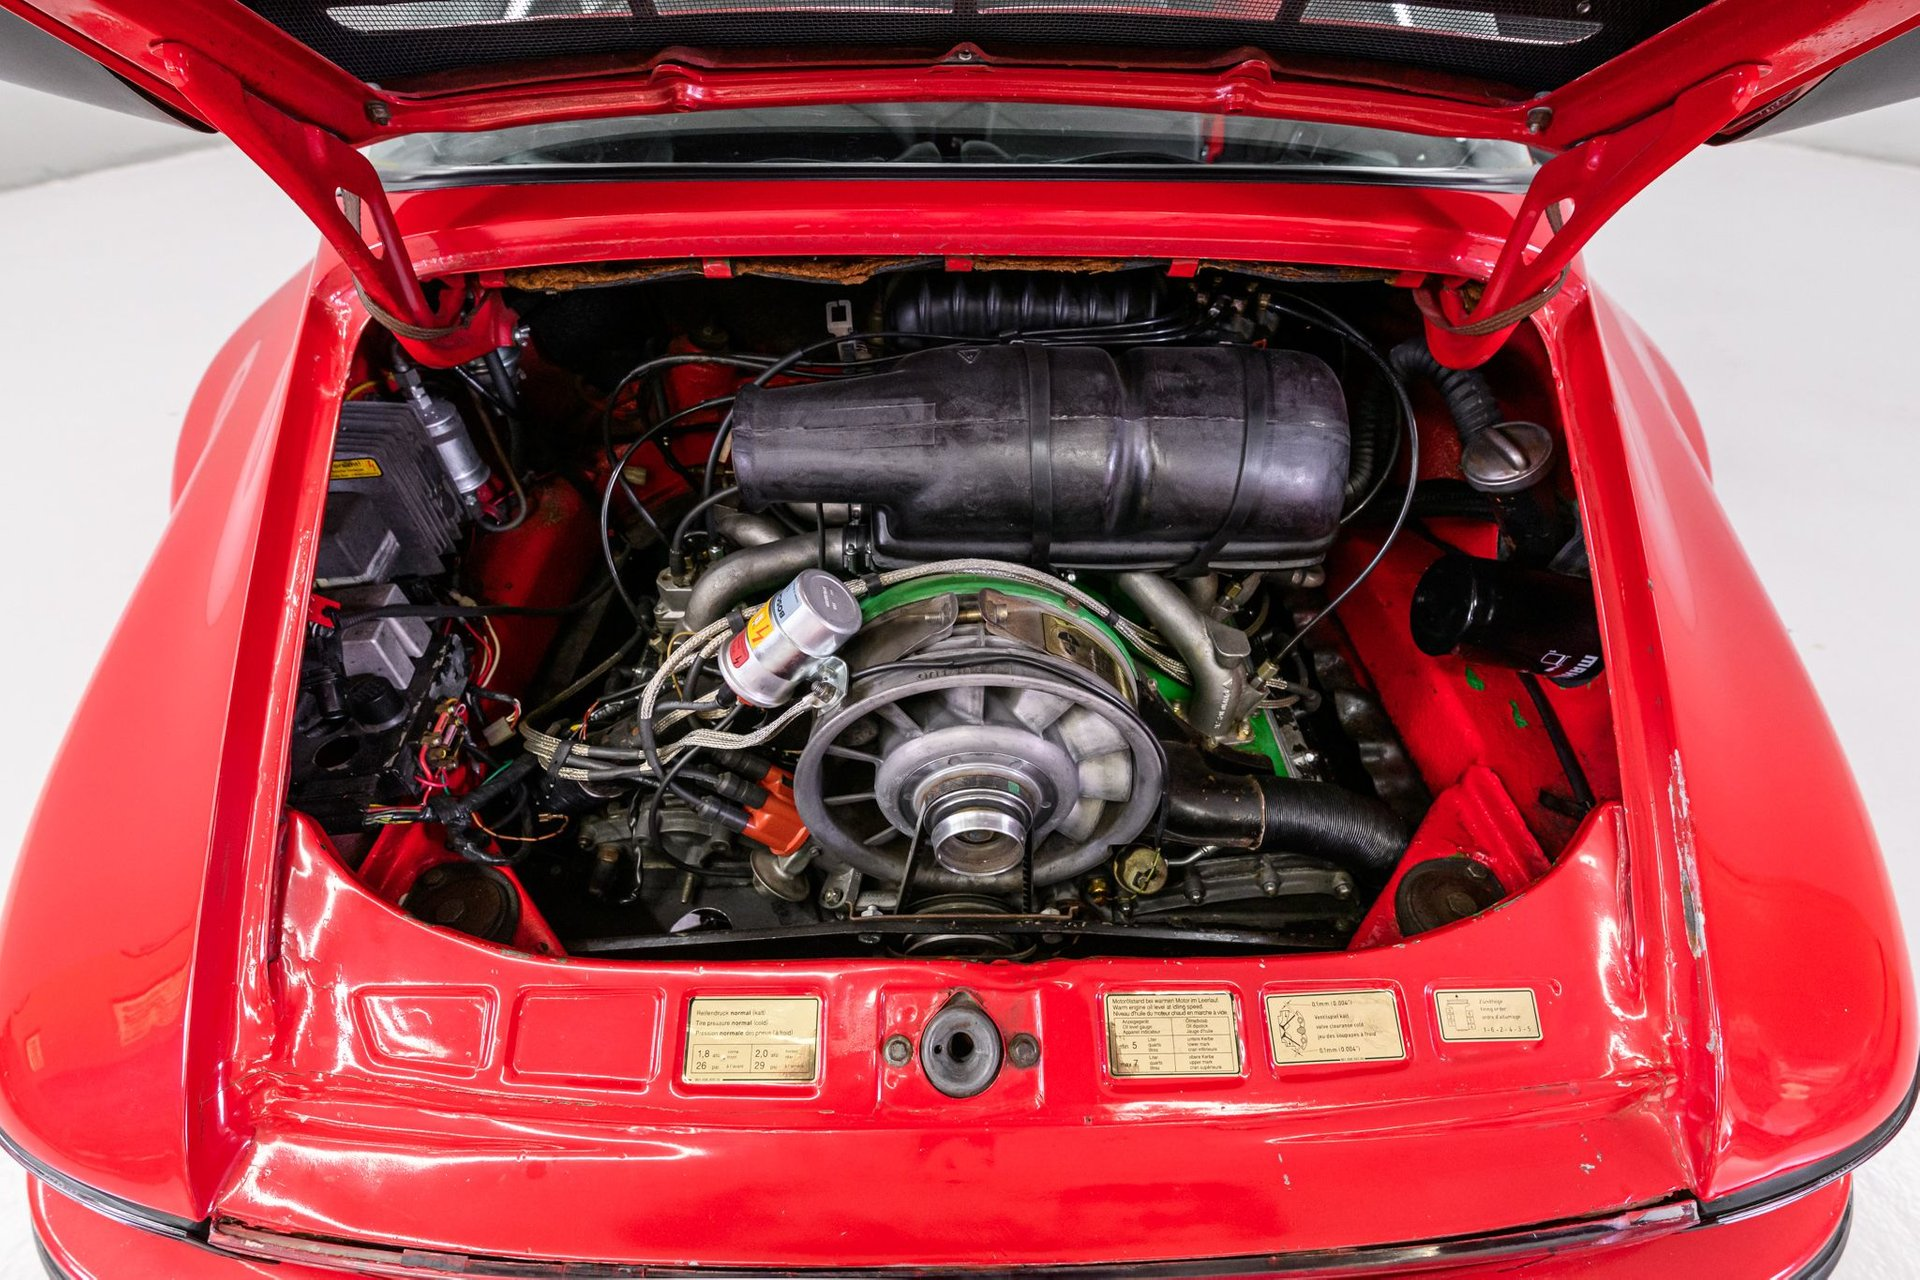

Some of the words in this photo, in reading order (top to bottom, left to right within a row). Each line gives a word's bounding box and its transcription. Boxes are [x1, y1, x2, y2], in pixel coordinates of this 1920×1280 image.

[775, 593, 787, 619] BOSC
[1132, 1041, 1138, 1050] 5
[698, 1048, 710, 1059] 1,8
[755, 1048, 768, 1059] 2,0
[696, 1061, 707, 1070] 26
[754, 1061, 766, 1070] 29
[1133, 1059, 1139, 1067] 7
